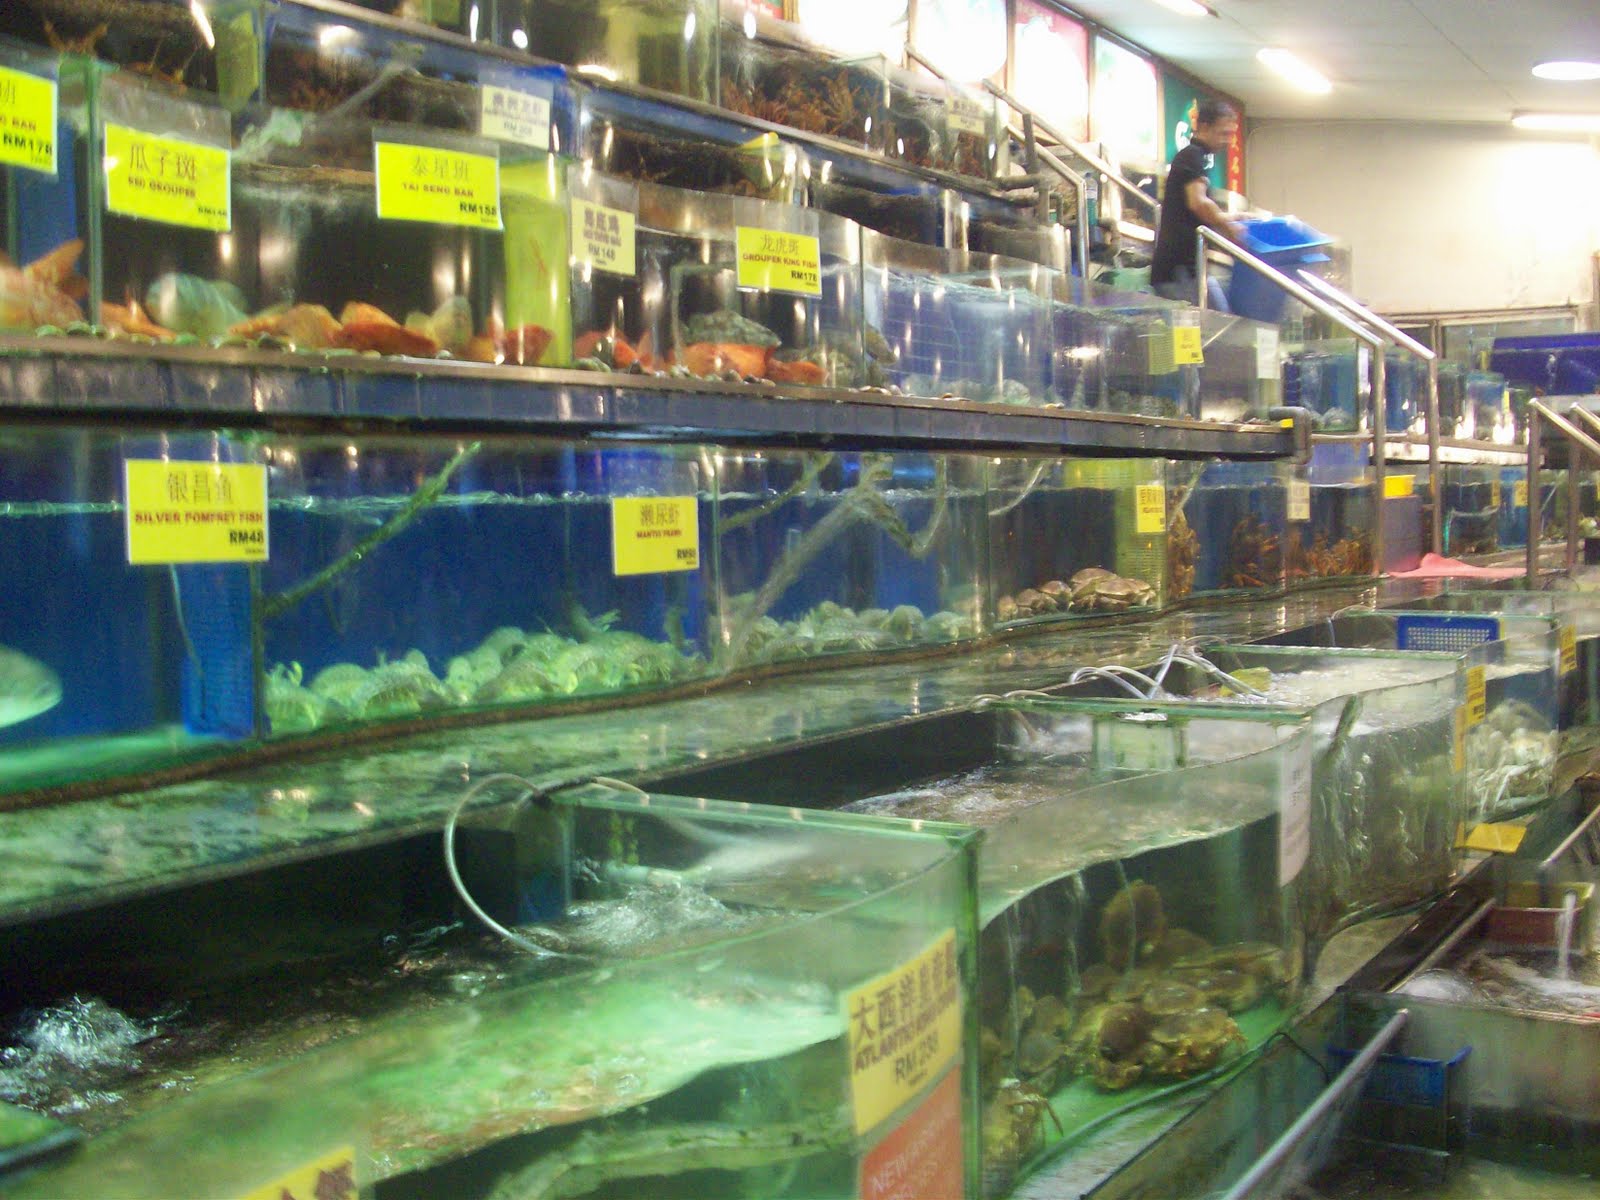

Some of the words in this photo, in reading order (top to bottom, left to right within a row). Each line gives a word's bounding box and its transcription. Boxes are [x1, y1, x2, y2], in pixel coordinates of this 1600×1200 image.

[12, 117, 36, 132] BAN
[129, 142, 197, 182] 瓜子斑
[149, 180, 196, 199] GROUPER
[402, 182, 419, 191] TAI
[454, 188, 474, 199] BAN
[459, 201, 498, 217] RM158
[760, 233, 800, 256] 龙虎斑
[742, 253, 782, 265] GROUPER
[802, 260, 818, 269] FISH
[167, 471, 234, 504] 银昌鱼
[134, 511, 181, 524] SILVER
[184, 511, 236, 523] POMFRET
[239, 511, 263, 523] FISH
[229, 530, 264, 545] RM48
